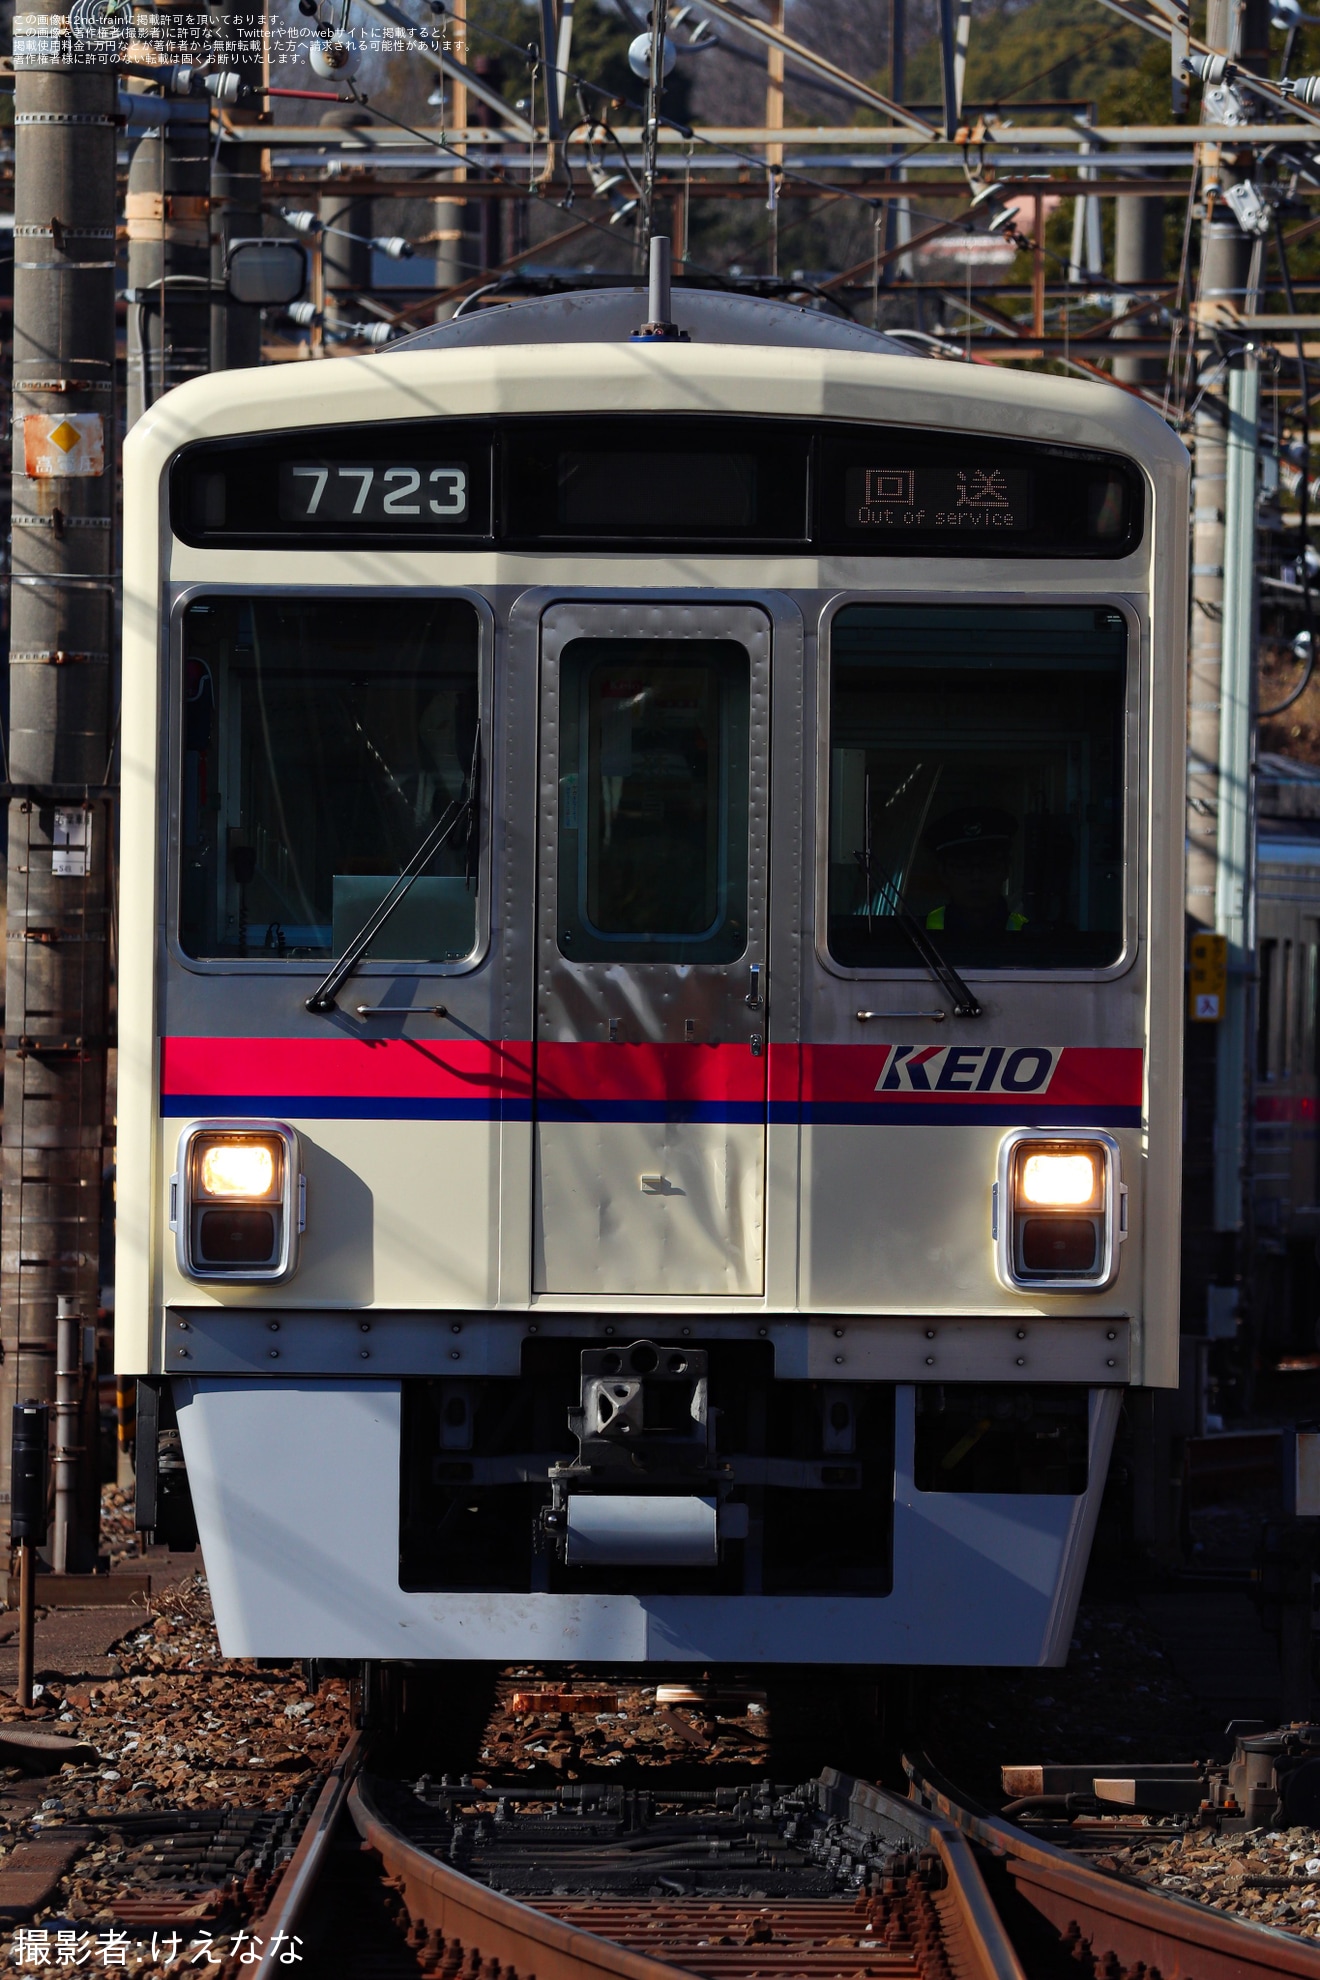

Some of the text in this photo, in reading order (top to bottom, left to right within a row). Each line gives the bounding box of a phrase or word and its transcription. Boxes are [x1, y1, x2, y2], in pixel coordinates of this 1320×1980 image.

[293, 467, 466, 515] 7723
[858, 506, 1014, 526] Out of service
[882, 1045, 1054, 1092] KEIO
